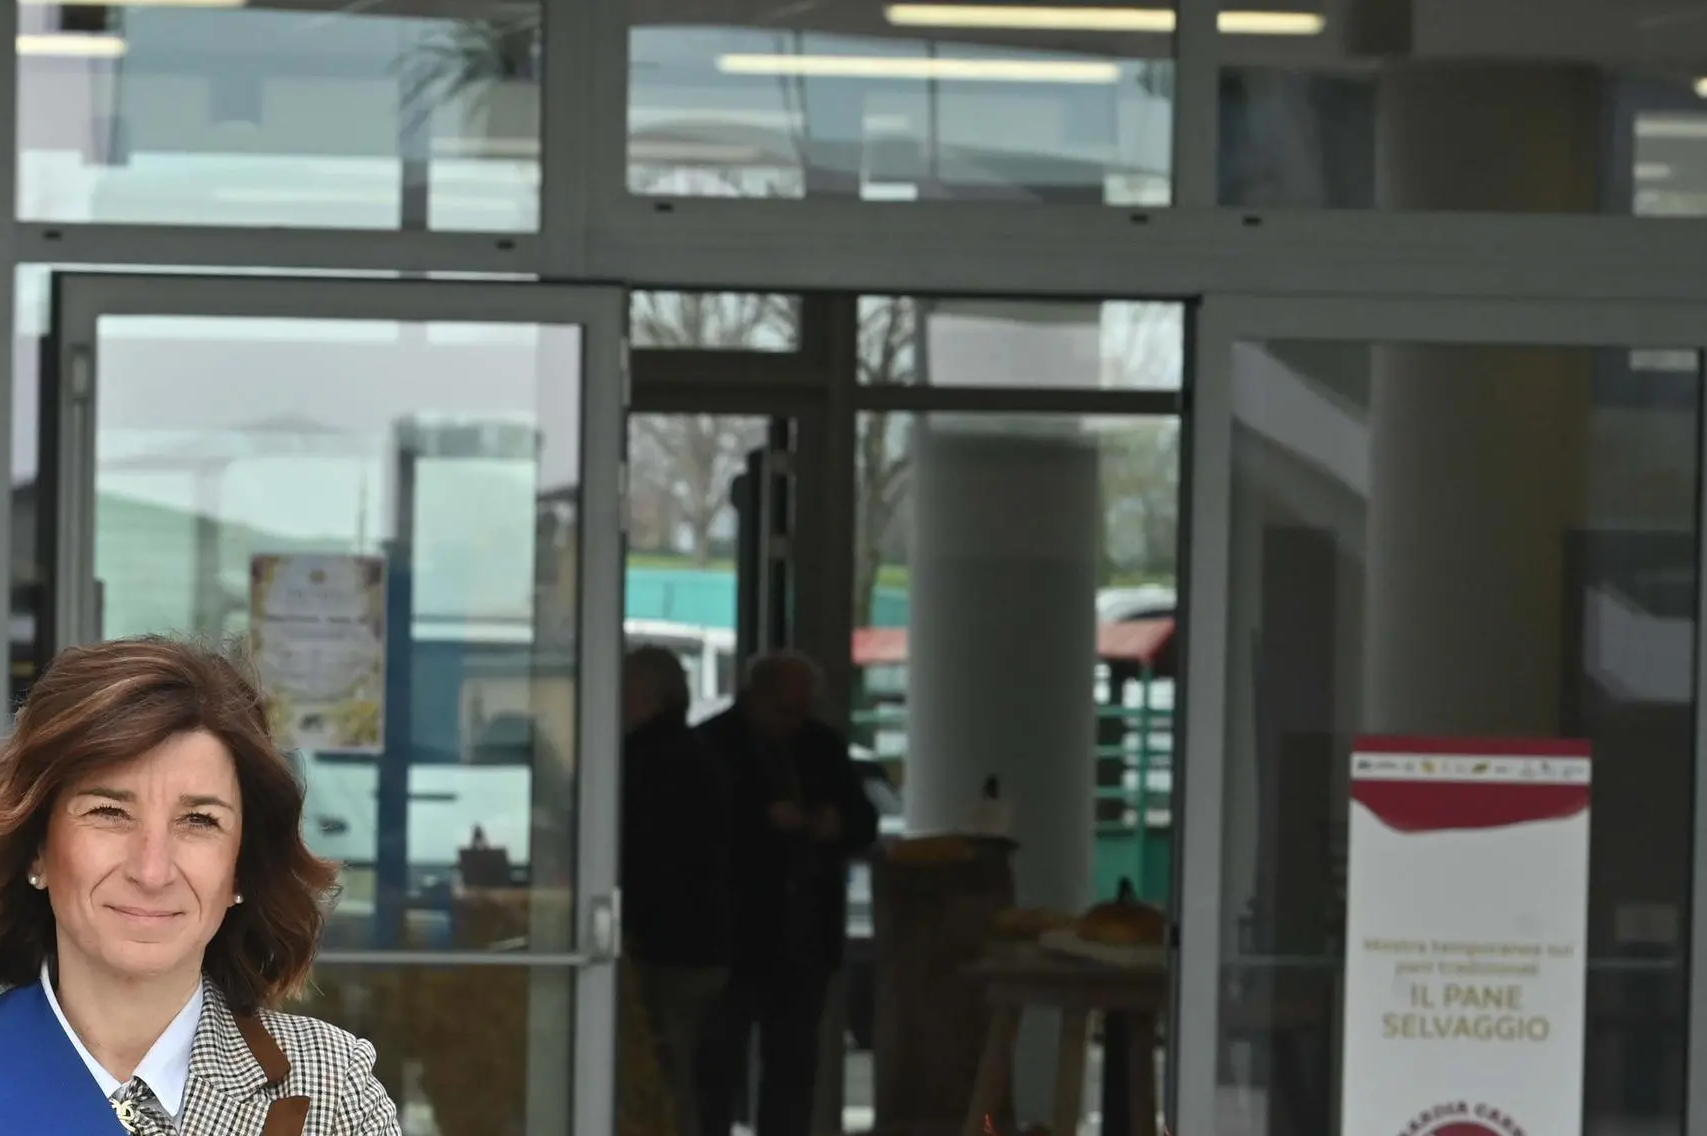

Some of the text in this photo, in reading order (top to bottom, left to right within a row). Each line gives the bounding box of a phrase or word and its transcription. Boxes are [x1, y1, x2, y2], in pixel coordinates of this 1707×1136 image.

[1411, 982, 1522, 1010] IL PANE
[1382, 1012, 1551, 1041] SELVAGGIO
